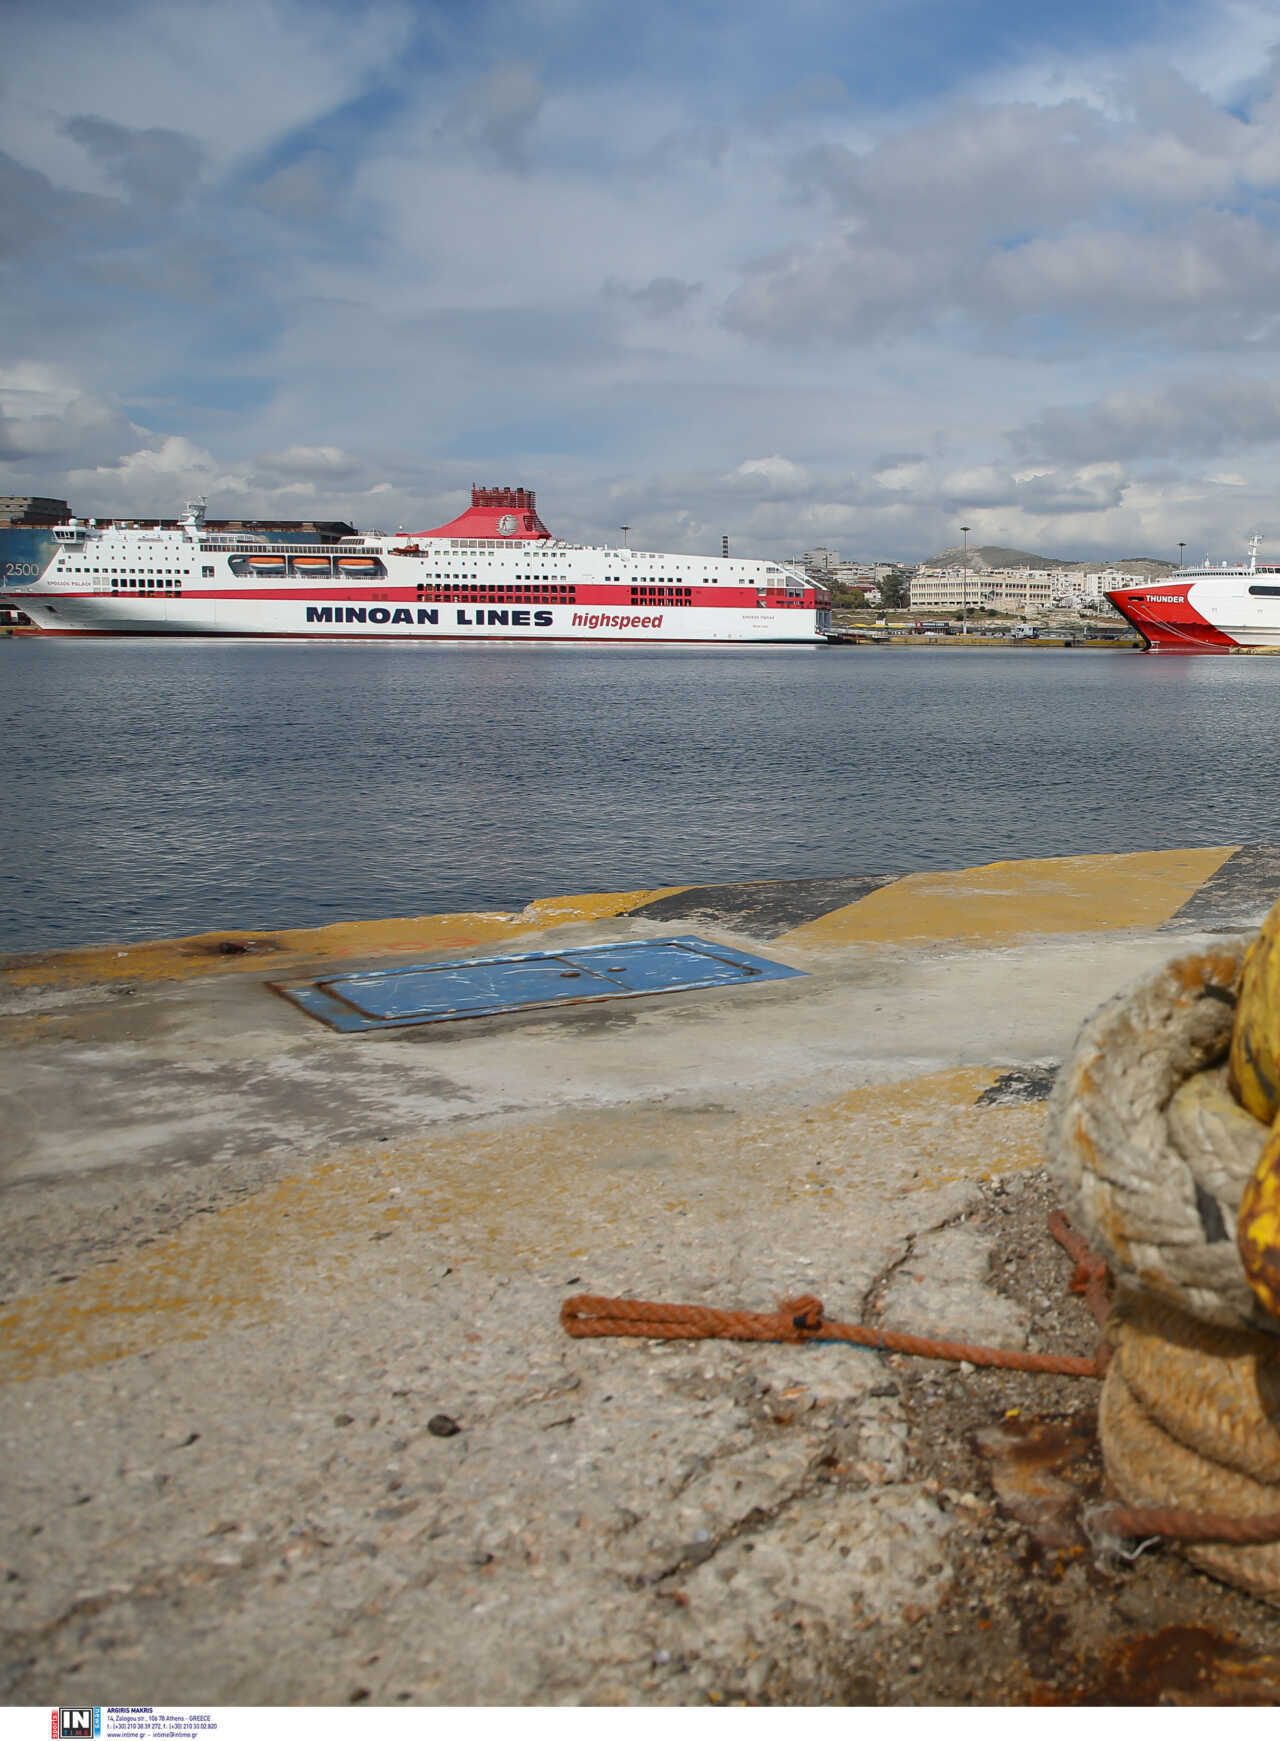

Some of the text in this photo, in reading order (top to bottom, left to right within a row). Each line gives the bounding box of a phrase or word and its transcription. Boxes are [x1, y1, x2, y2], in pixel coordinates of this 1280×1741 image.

[6, 563, 40, 576] 2500
[1145, 594, 1185, 605] THUNDER
[306, 606, 554, 627] MINOAN LINES
[571, 611, 664, 633] highspeed
